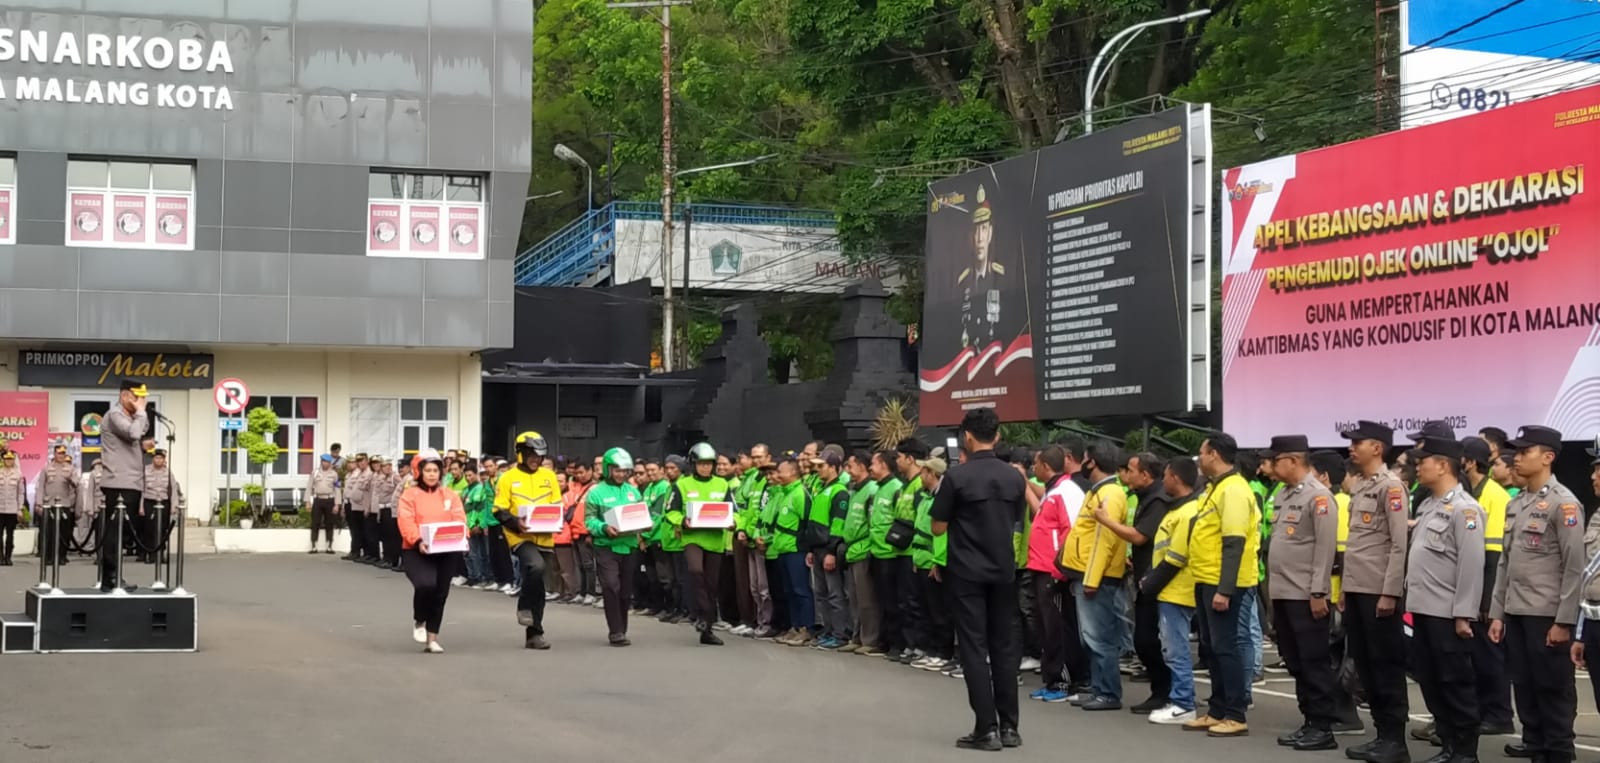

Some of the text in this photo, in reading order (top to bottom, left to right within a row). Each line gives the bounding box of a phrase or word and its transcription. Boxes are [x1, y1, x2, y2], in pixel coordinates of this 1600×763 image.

[15, 76, 149, 106] MALANG
[157, 83, 233, 110] KOTA
[1055, 185, 1084, 209] PROGRAM
[1084, 177, 1116, 203] PRIORITAS
[1116, 169, 1144, 194] KAPOLRI
[1253, 164, 1585, 248] APEL KEBANGSAAN & DEKLARASI
[815, 262, 887, 279] MALANG
[1266, 255, 1360, 289] PENGEMUDI
[1362, 248, 1407, 277] OJEK
[1409, 236, 1479, 270] ONLINE
[1305, 280, 1509, 325] GUNA MEMPERTAHANKAN
[1237, 332, 1320, 358] KAMTIBMAS
[1322, 327, 1364, 350] YANG
[1367, 318, 1446, 347] KONDUSIF
[1450, 315, 1467, 339] DI
[1471, 311, 1521, 336] KOTA
[25, 352, 211, 385] PRIMKOPPOL Makota
[1392, 418, 1404, 431] 24
